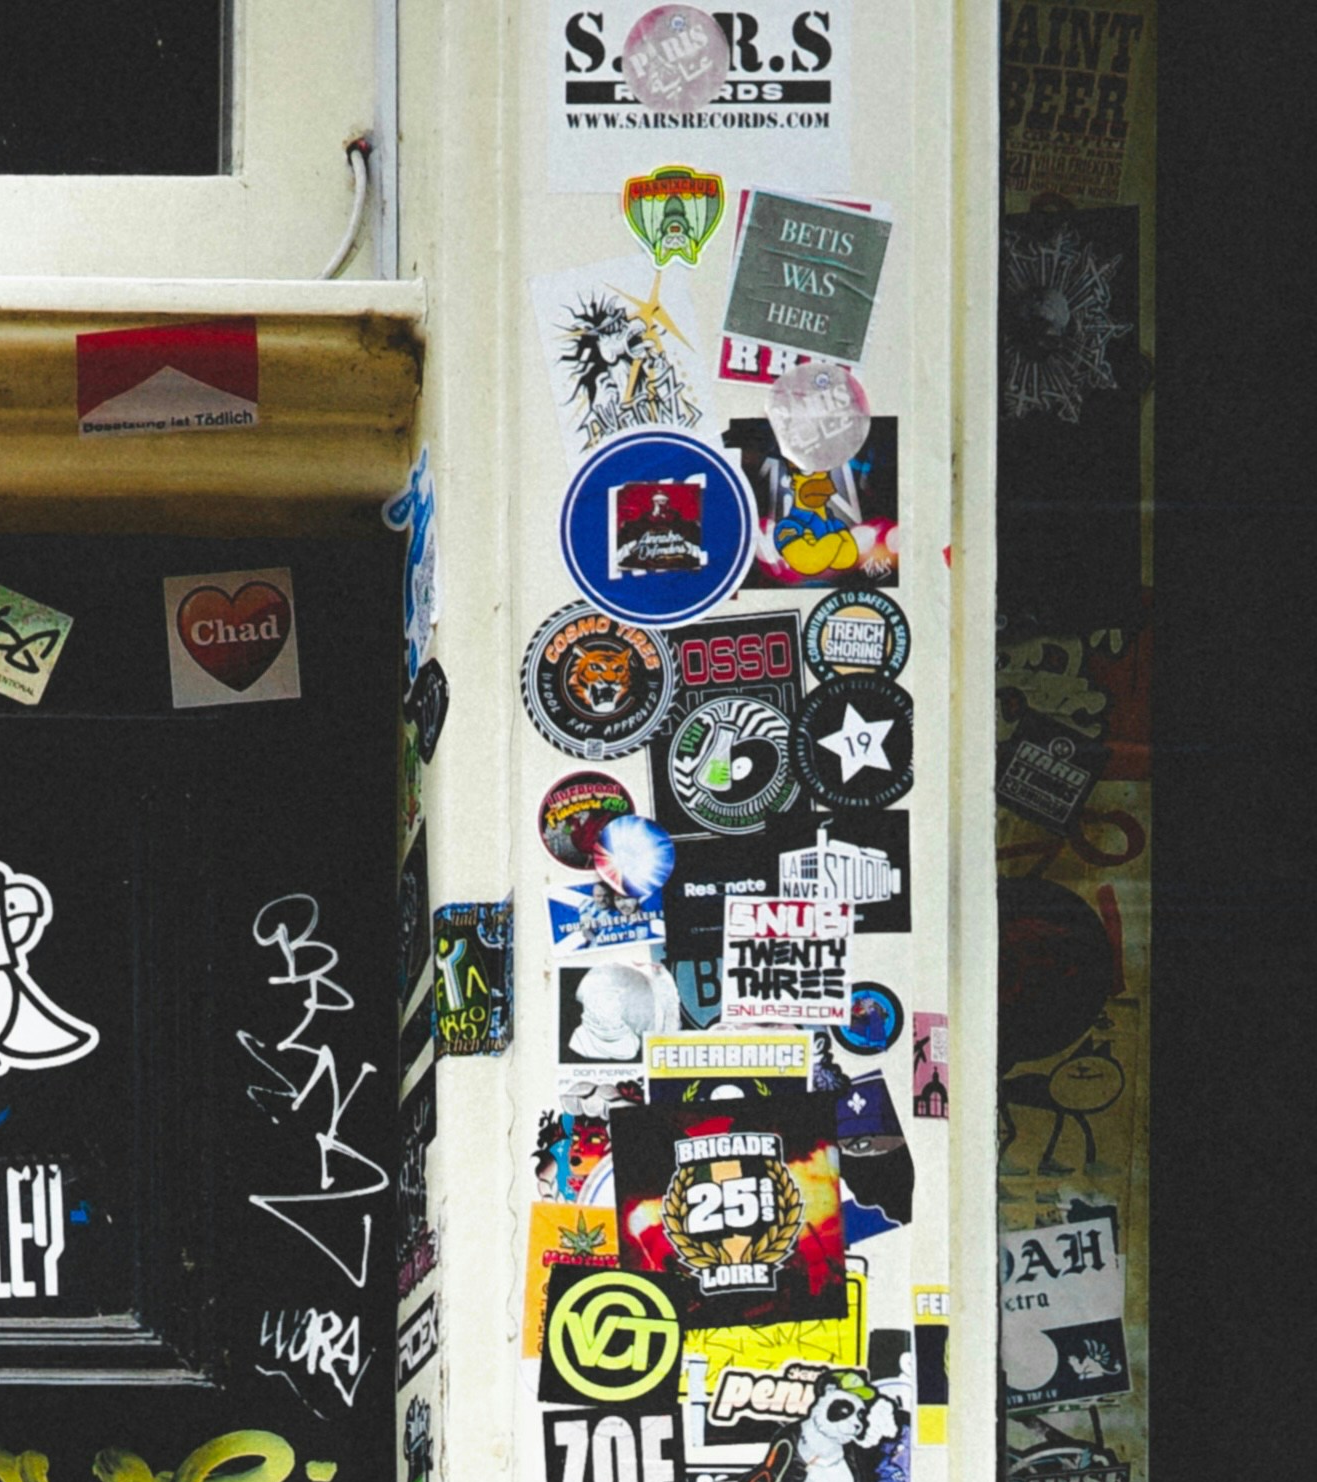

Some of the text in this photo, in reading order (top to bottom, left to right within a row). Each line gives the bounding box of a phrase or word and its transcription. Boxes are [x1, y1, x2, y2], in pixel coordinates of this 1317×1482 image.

[566, 111, 831, 130] WWW.SARSRECORDS.COM
[779, 218, 855, 256] BETIS
[781, 262, 837, 297] WAS
[767, 302, 830, 335] HERE
[190, 616, 281, 647] Chad
[826, 622, 884, 643] TRENCH
[825, 639, 884, 660] SHORING
[844, 732, 874, 758] 19
[729, 901, 849, 937] SNUB
[729, 939, 847, 968] TWENTY
[727, 968, 846, 1001] THREE
[725, 1003, 845, 1020] SNUB23.COM
[677, 1136, 776, 1160] BRIGADE
[685, 1179, 757, 1235] 25
[703, 1264, 770, 1287] LOIRE
